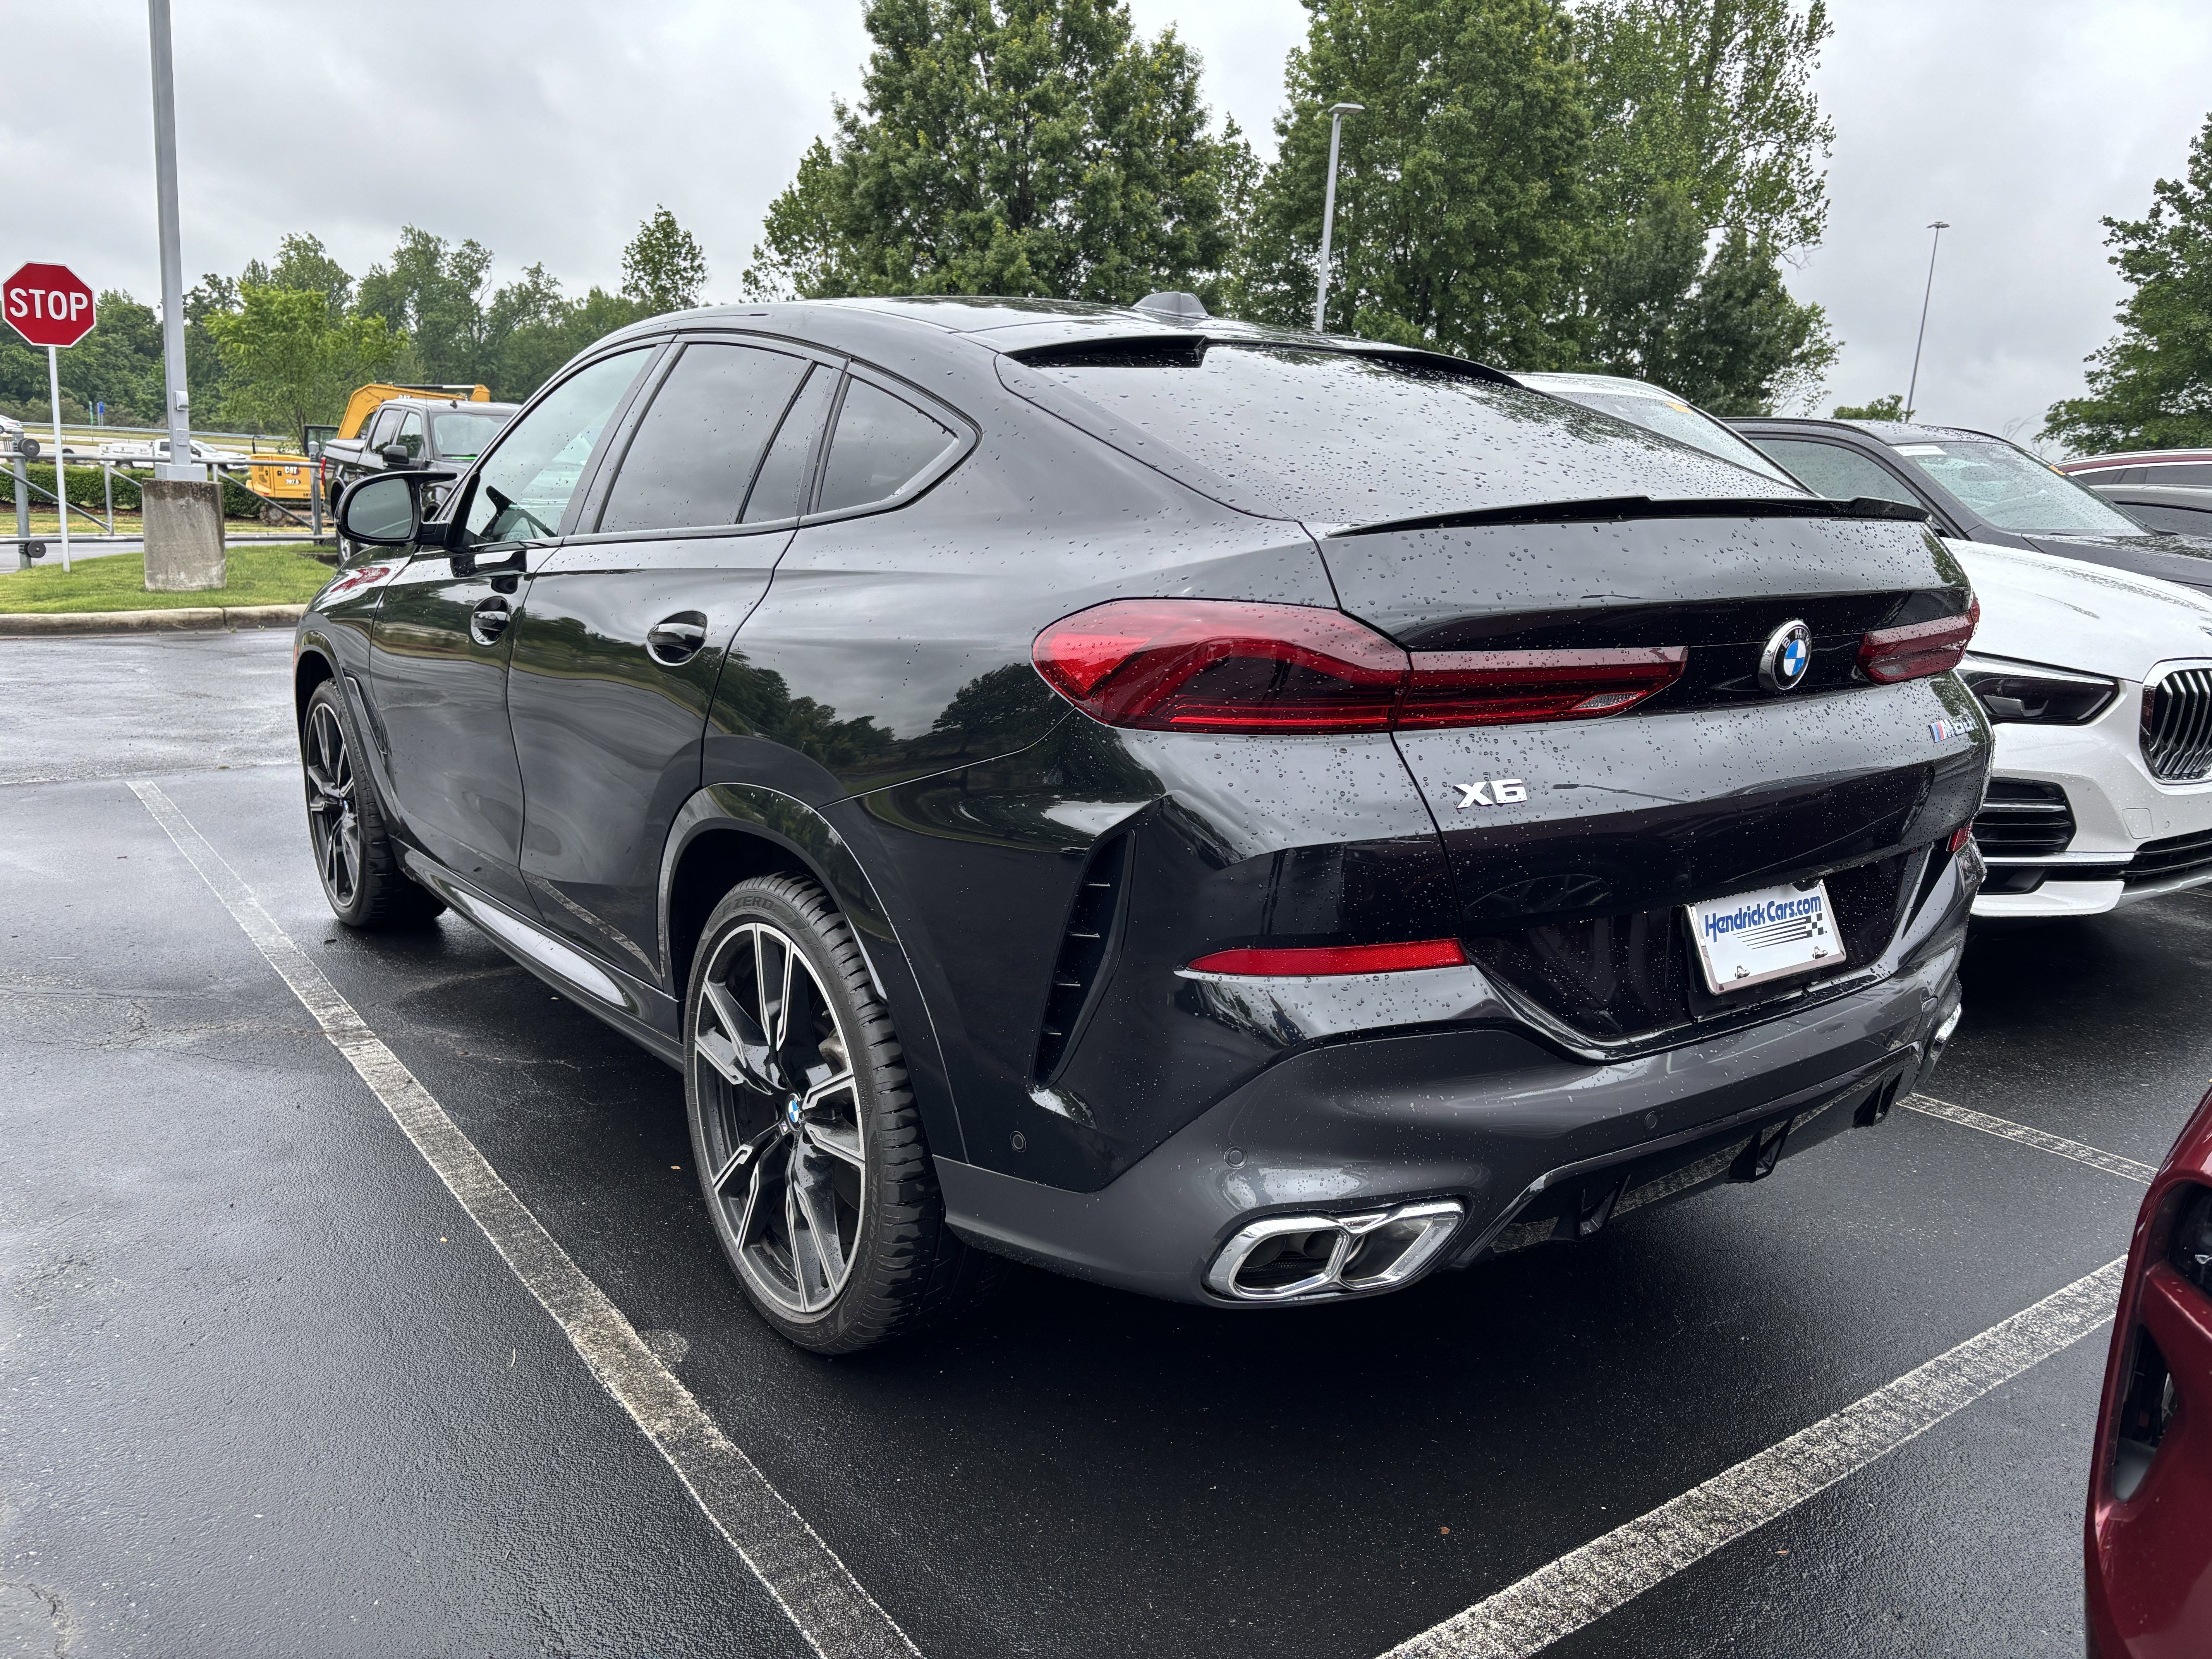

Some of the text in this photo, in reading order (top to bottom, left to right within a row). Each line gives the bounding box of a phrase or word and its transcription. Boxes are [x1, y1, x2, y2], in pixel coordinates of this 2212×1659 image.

[10, 288, 88, 321] STOP
[285, 466, 297, 474] CAT
[1453, 778, 1528, 809] X6
[733, 896, 775, 911] ZERO
